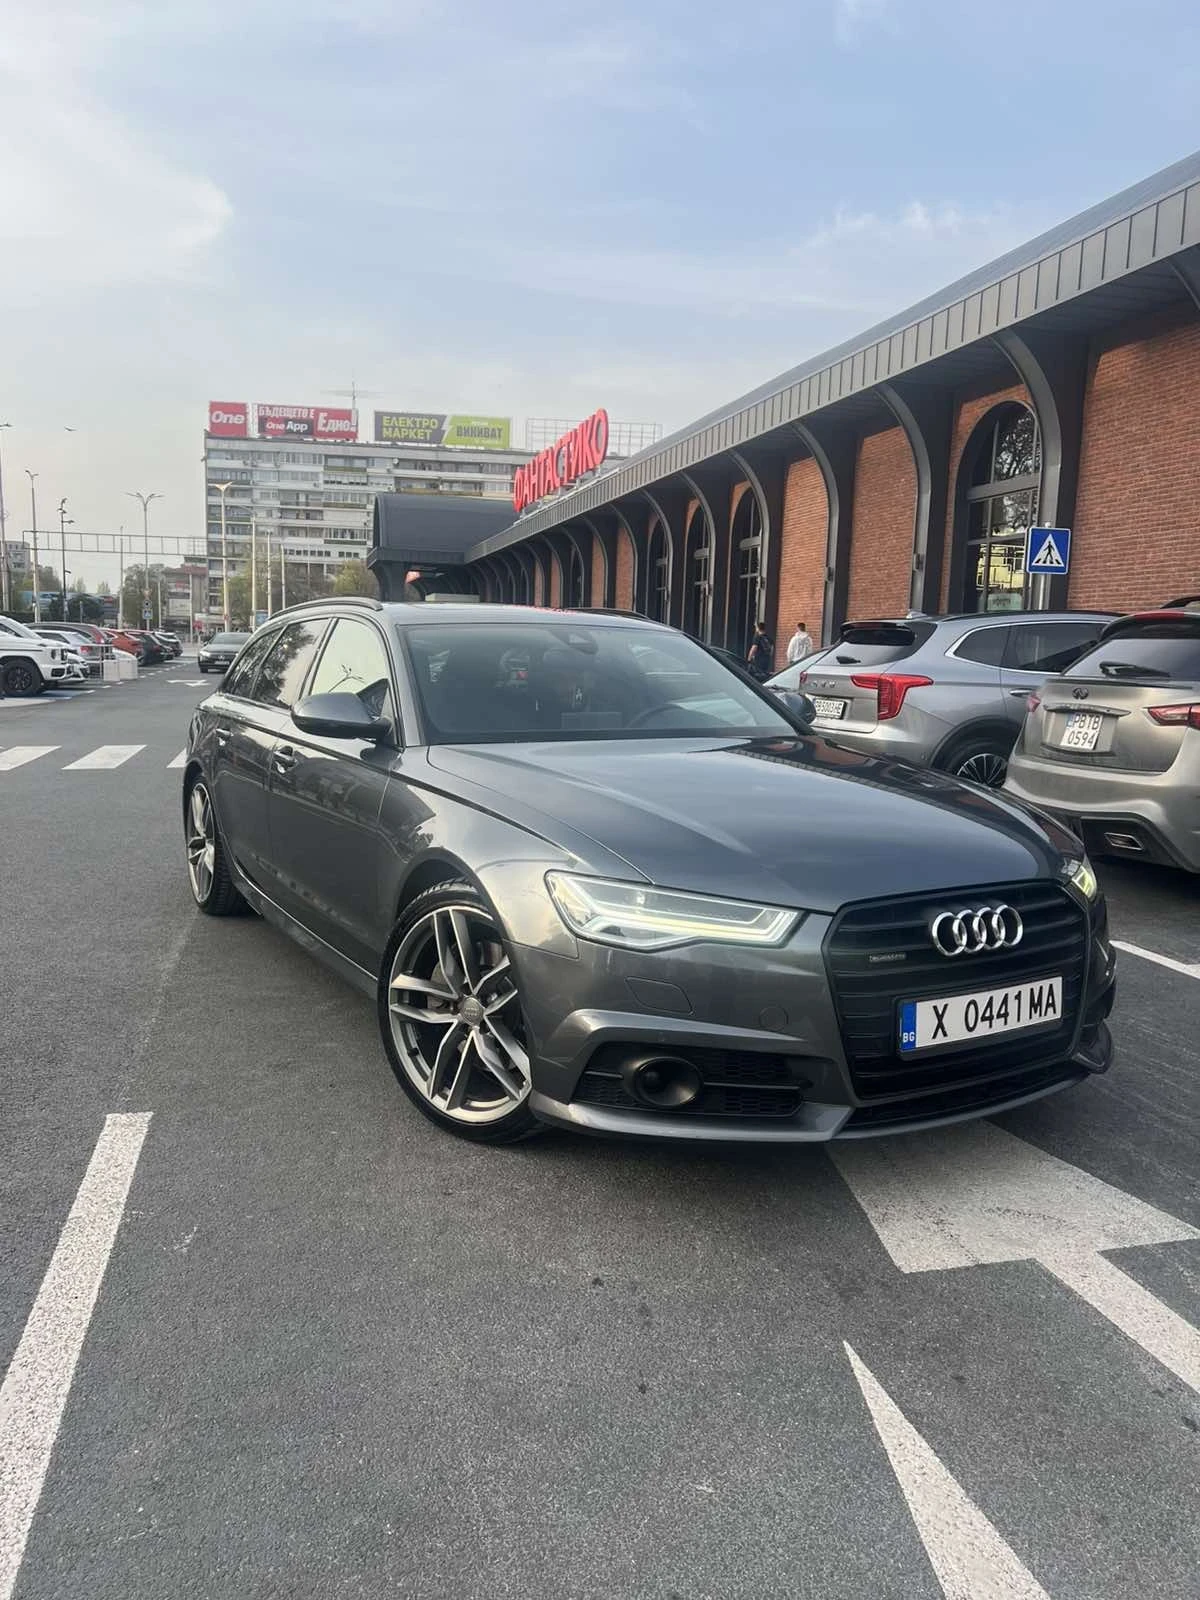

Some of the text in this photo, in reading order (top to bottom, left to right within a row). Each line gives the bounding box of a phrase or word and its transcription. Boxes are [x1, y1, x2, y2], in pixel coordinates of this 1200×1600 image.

[211, 411, 245, 424] One
[258, 406, 315, 418] БЪДЕЩЕТО Е
[266, 420, 308, 432] One App
[317, 410, 357, 432] Едно!
[382, 416, 438, 429] ЕЛЕКТРО
[382, 428, 432, 440] МАРКЕТ
[513, 408, 608, 512] ФАНТАСТИКО
[1067, 731, 1096, 748] 0594
[931, 1002, 949, 1040] X
[902, 1032, 915, 1043] BG
